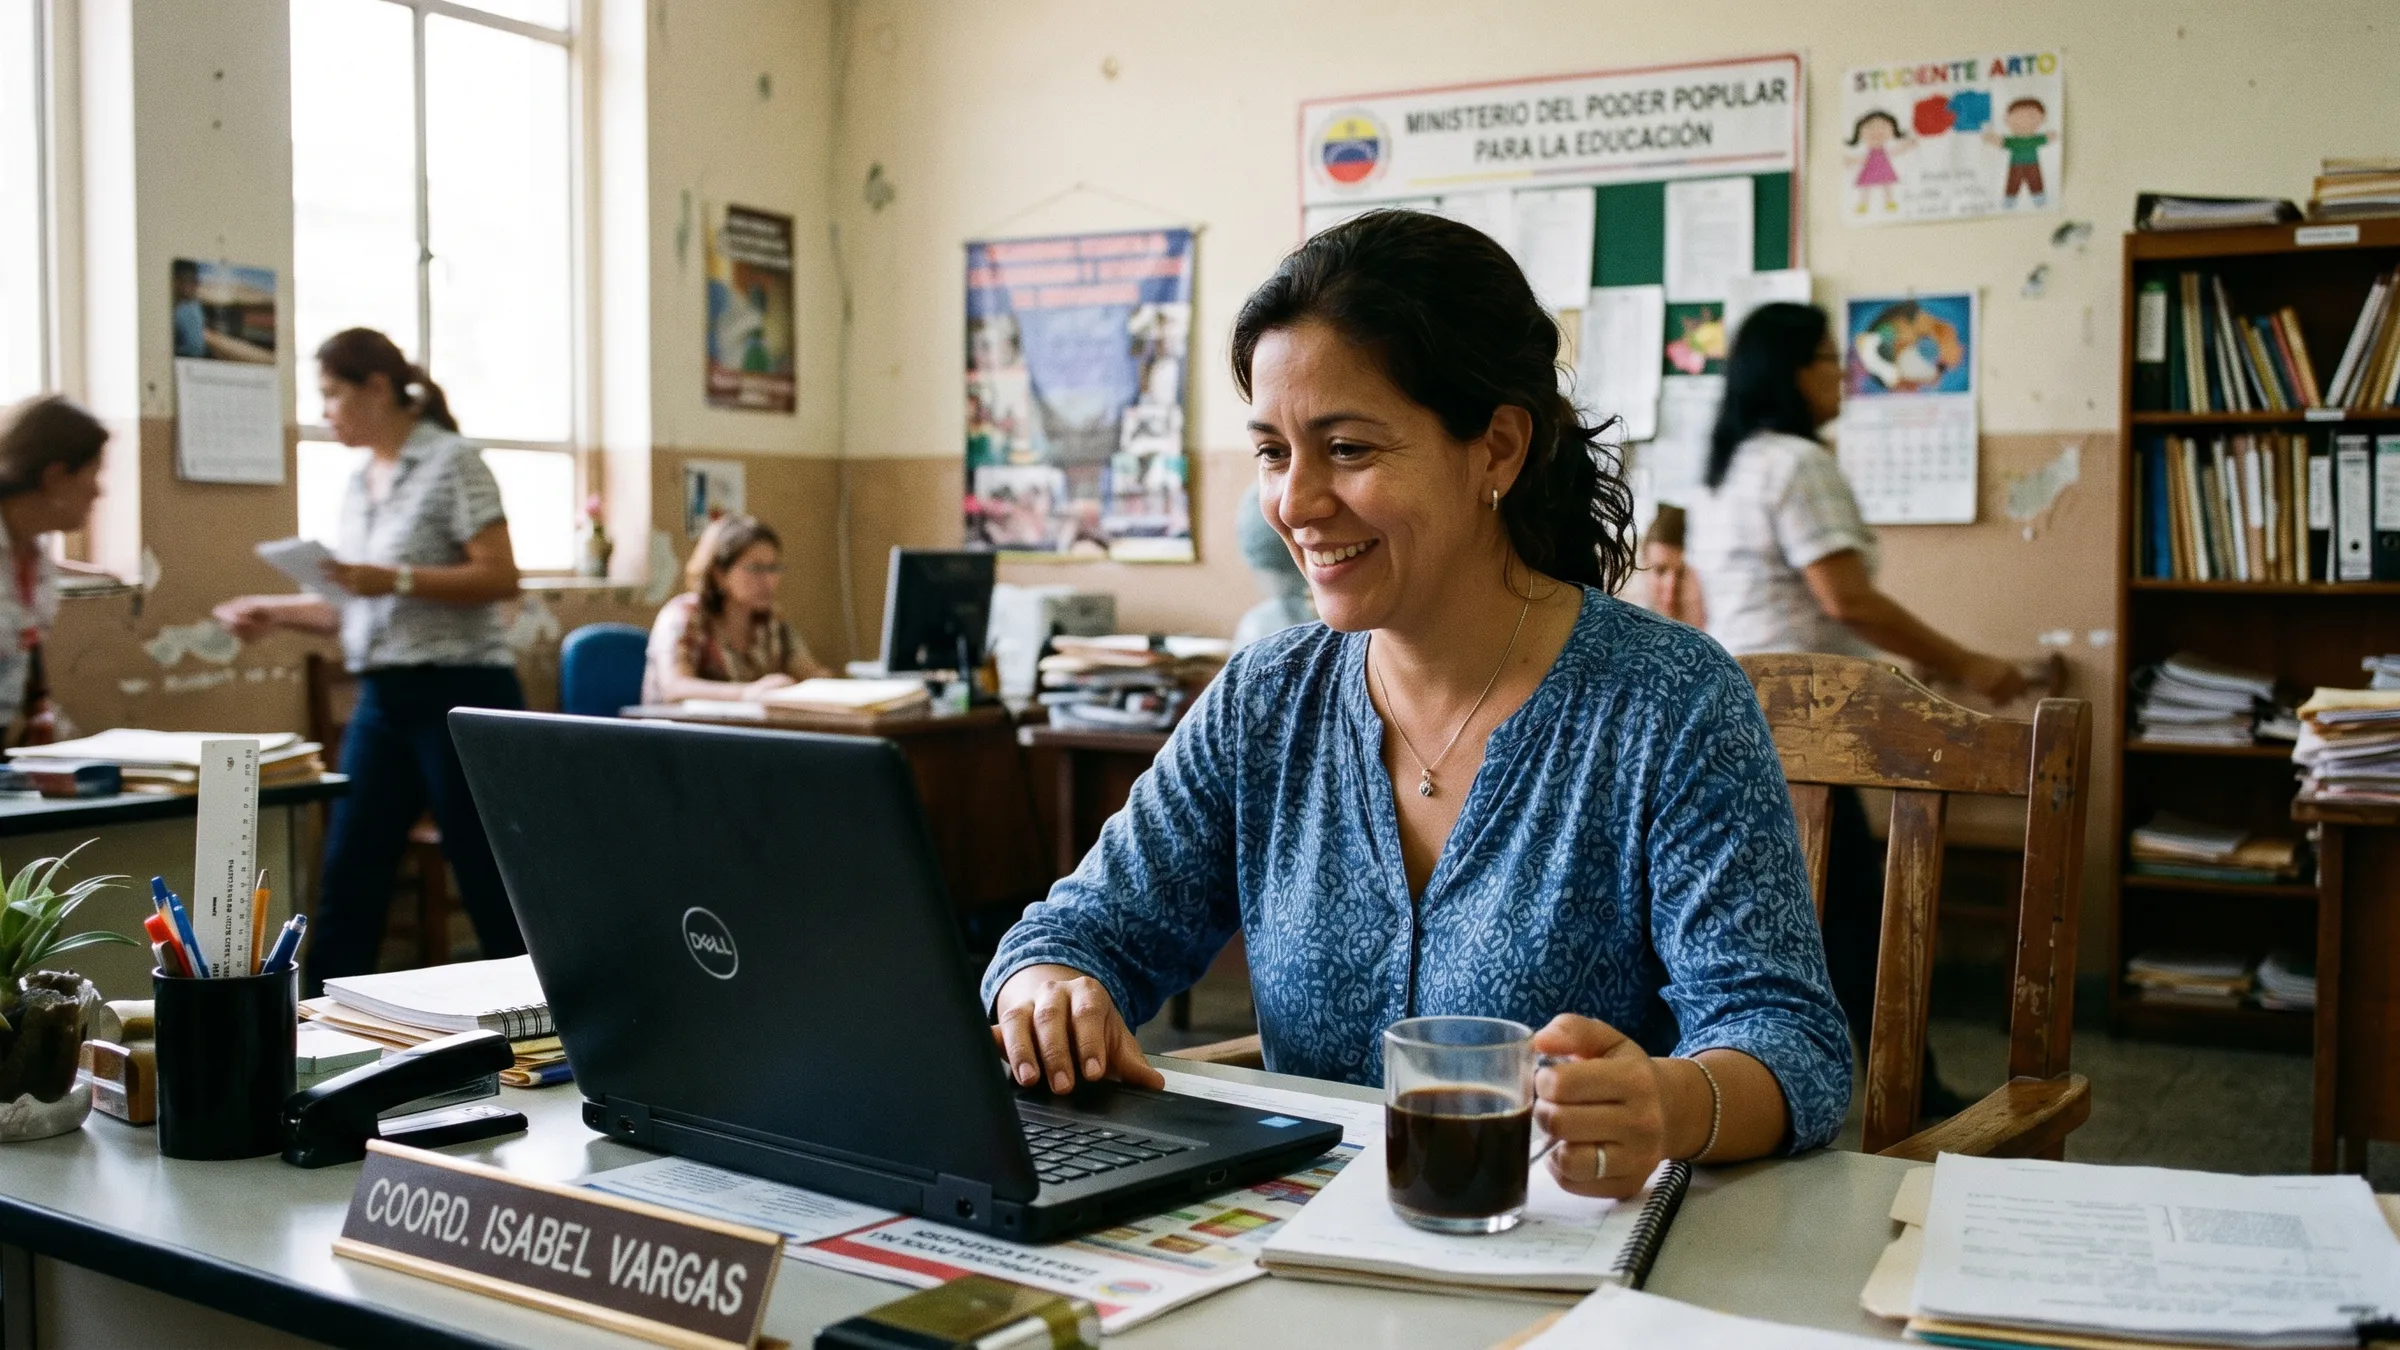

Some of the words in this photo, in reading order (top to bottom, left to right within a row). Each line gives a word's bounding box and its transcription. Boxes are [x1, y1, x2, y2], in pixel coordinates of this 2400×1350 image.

[1990, 53, 2058, 77] ARTO
[1406, 101, 1530, 134] MINISTERIO
[1536, 98, 1579, 124] DEL
[1586, 88, 1665, 119] PODER
[1673, 78, 1788, 111] POPULAR
[1474, 137, 1534, 162] PARA
[1539, 133, 1569, 158] LA
[1576, 119, 1714, 154] EDUCACIÓN
[689, 932, 733, 955] DELL
[365, 1177, 470, 1247] COORD.
[480, 1204, 593, 1278] ISABEL
[609, 1234, 748, 1316] VARGAS
